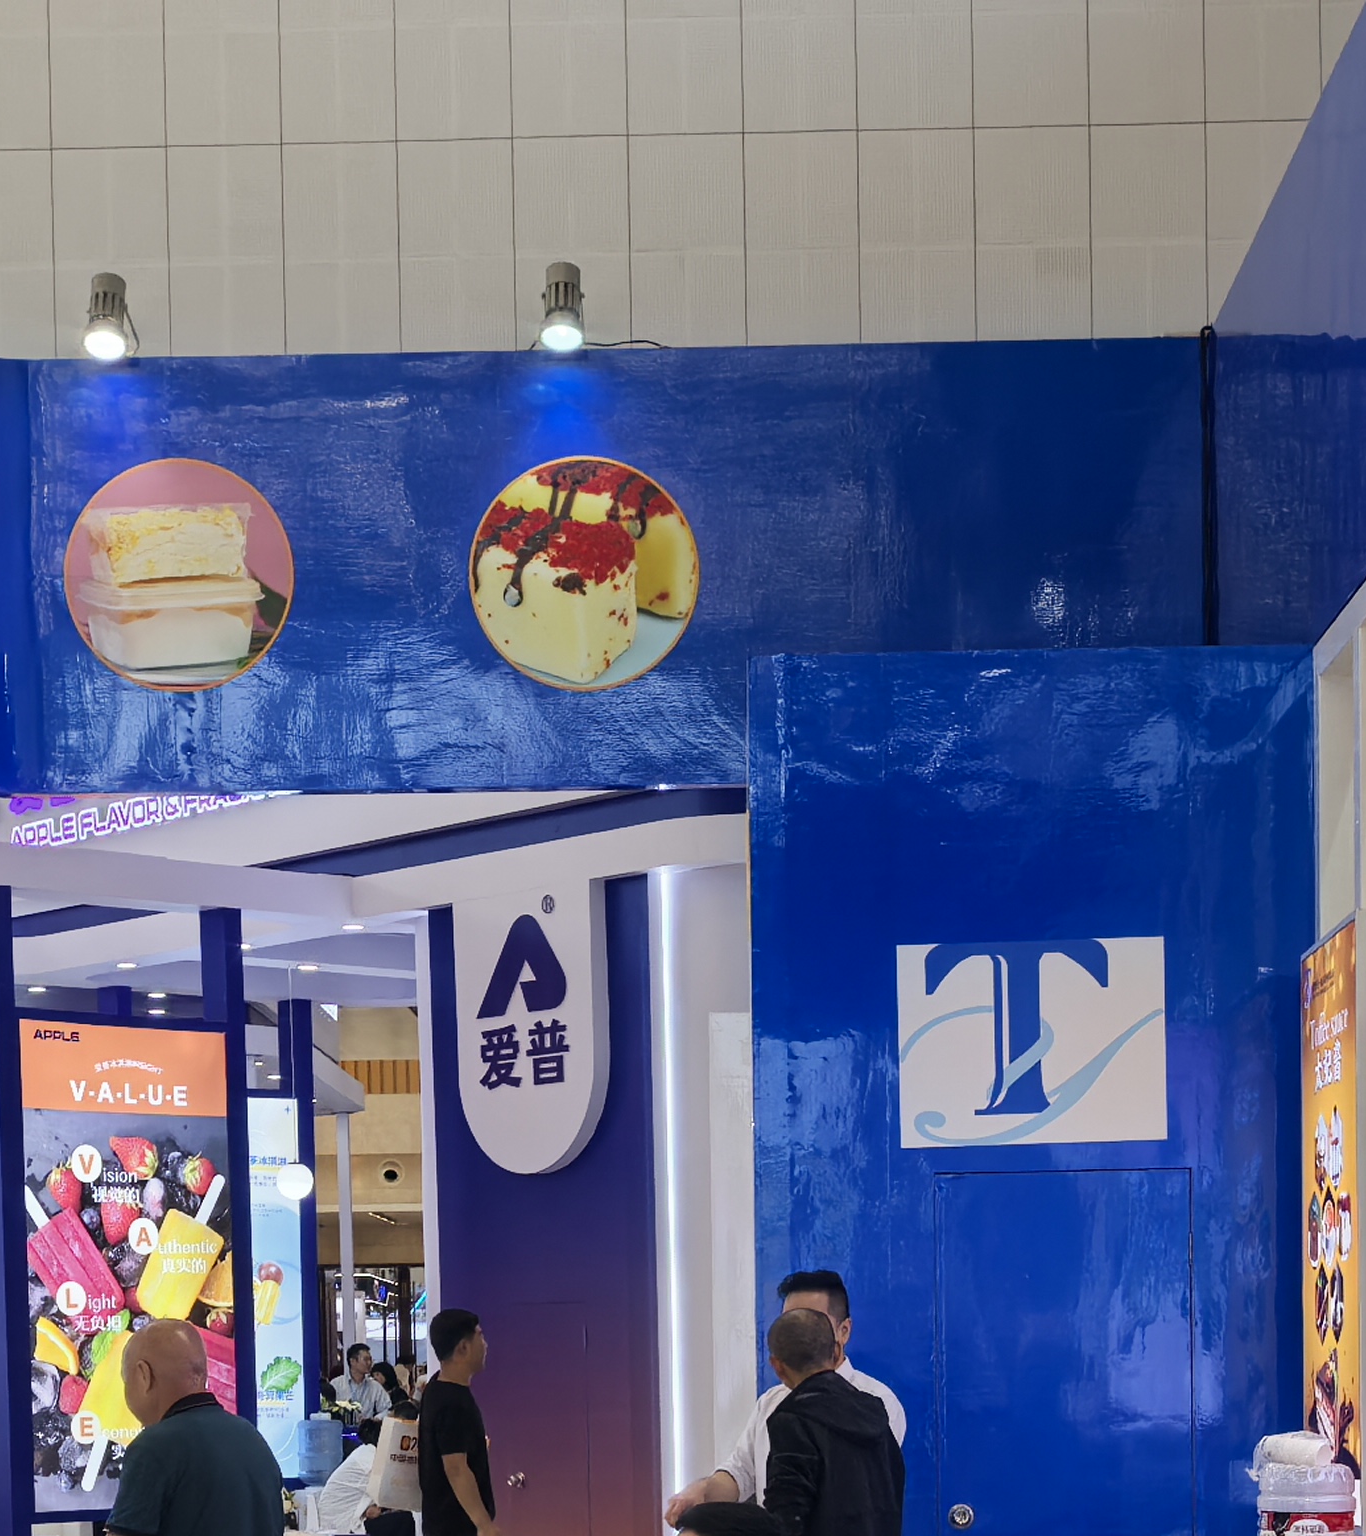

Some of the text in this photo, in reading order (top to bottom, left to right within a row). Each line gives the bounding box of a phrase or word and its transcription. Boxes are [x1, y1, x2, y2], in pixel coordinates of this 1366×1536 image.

[10, 812, 77, 847] APPLE
[77, 796, 162, 840] FLAVOR
[480, 1019, 570, 1090] 爱普
[161, 1257, 207, 1275] 真实的
[74, 1315, 122, 1332] 无负担
